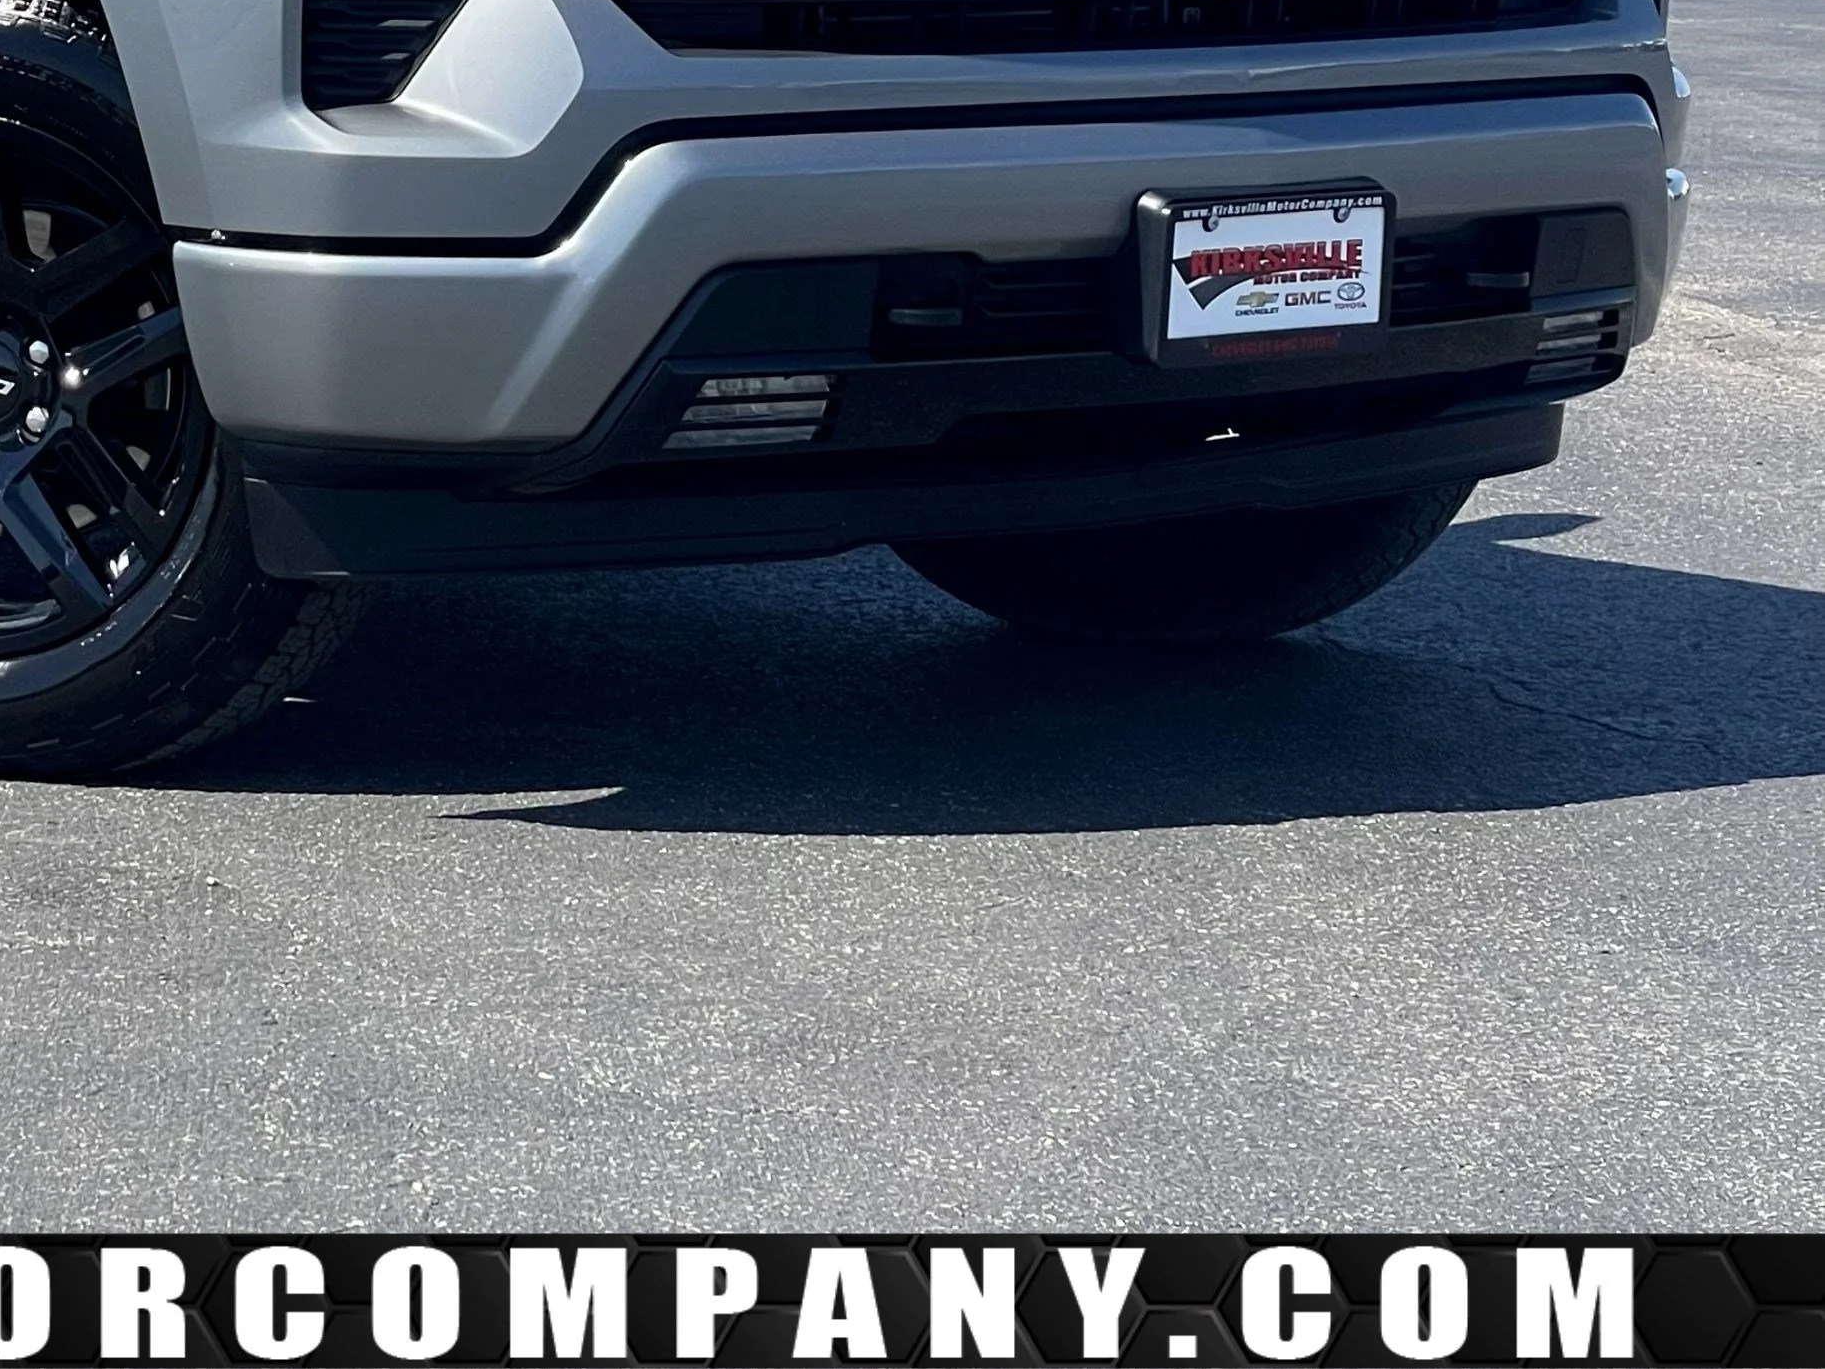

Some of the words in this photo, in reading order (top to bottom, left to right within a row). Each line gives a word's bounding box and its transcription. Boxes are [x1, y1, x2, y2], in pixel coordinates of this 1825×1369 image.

[1182, 196, 1382, 219] www.KirksvilleMotorCompany.com
[1190, 239, 1363, 277] KIRKSVILLE
[1253, 272, 1297, 286] MOTOR
[1300, 270, 1360, 282] COMPANY
[1285, 291, 1331, 306] GMC
[1334, 302, 1367, 310] TOYOTA
